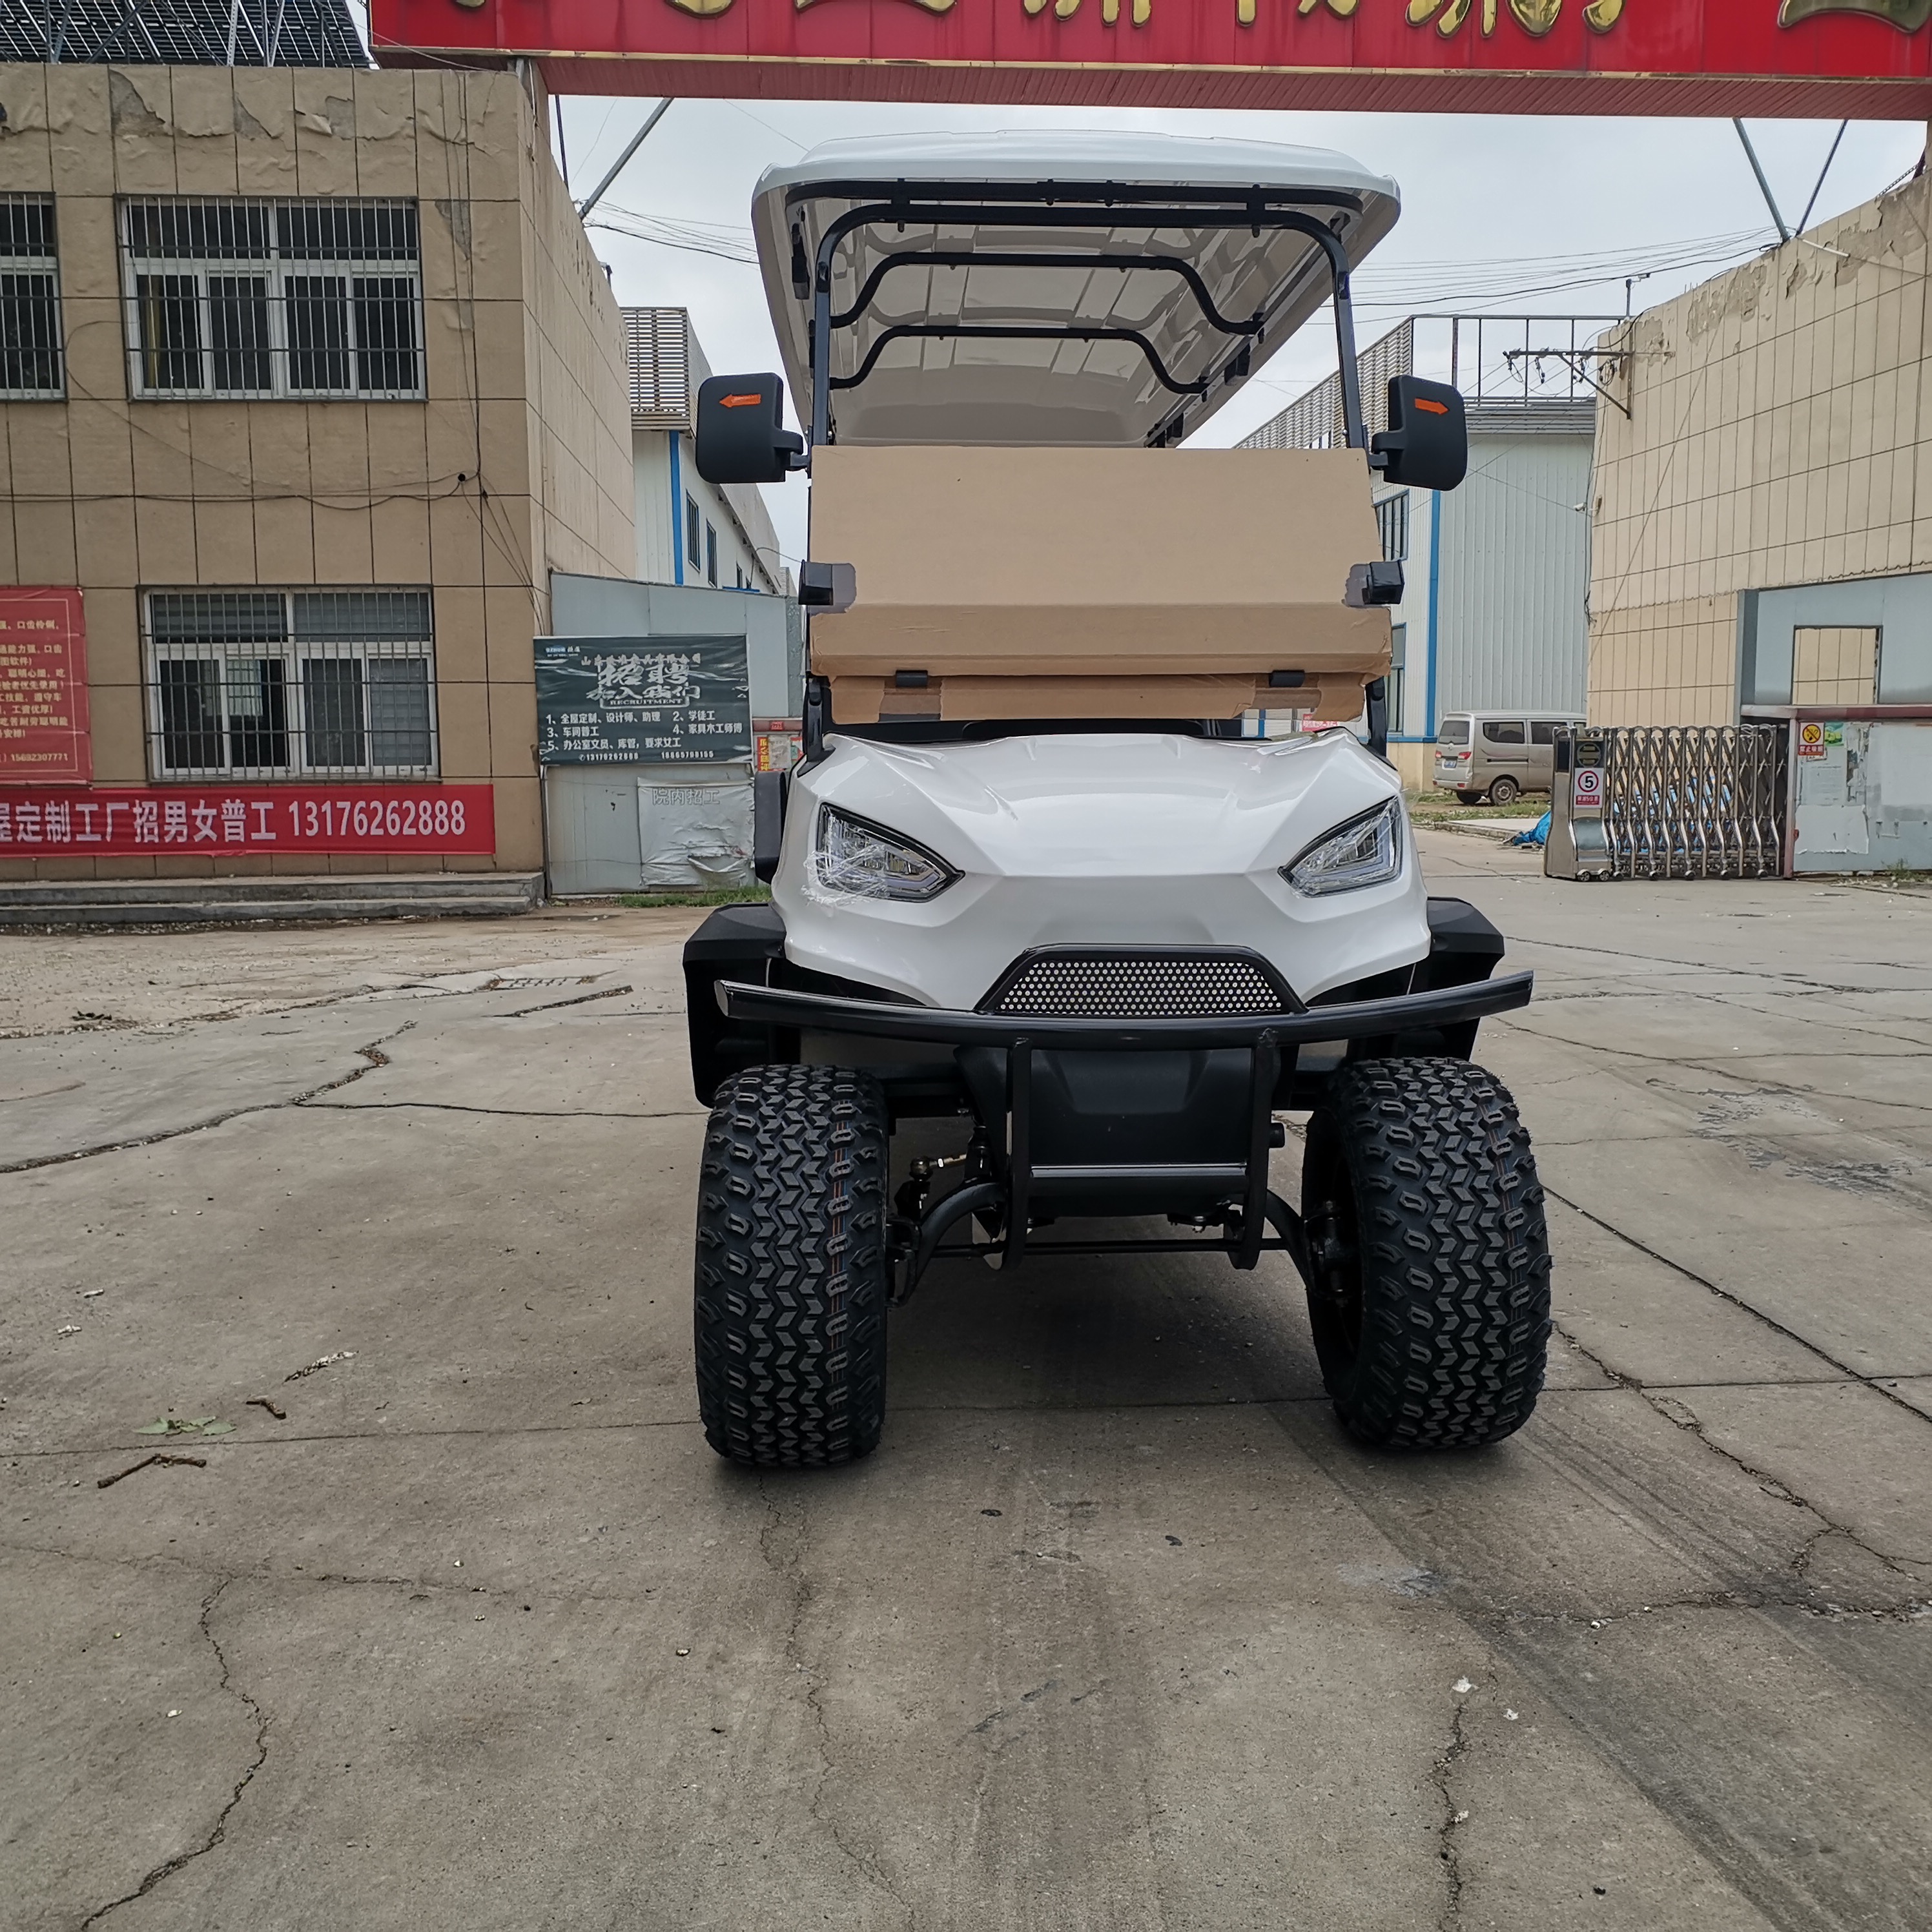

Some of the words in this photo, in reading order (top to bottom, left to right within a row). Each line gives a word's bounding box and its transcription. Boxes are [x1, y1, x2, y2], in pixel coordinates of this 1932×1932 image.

[610, 698, 684, 706] RECRUITMENT
[1585, 776, 1594, 788] 5
[652, 787, 721, 806] 院内招工
[288, 799, 466, 837] 13176262888
